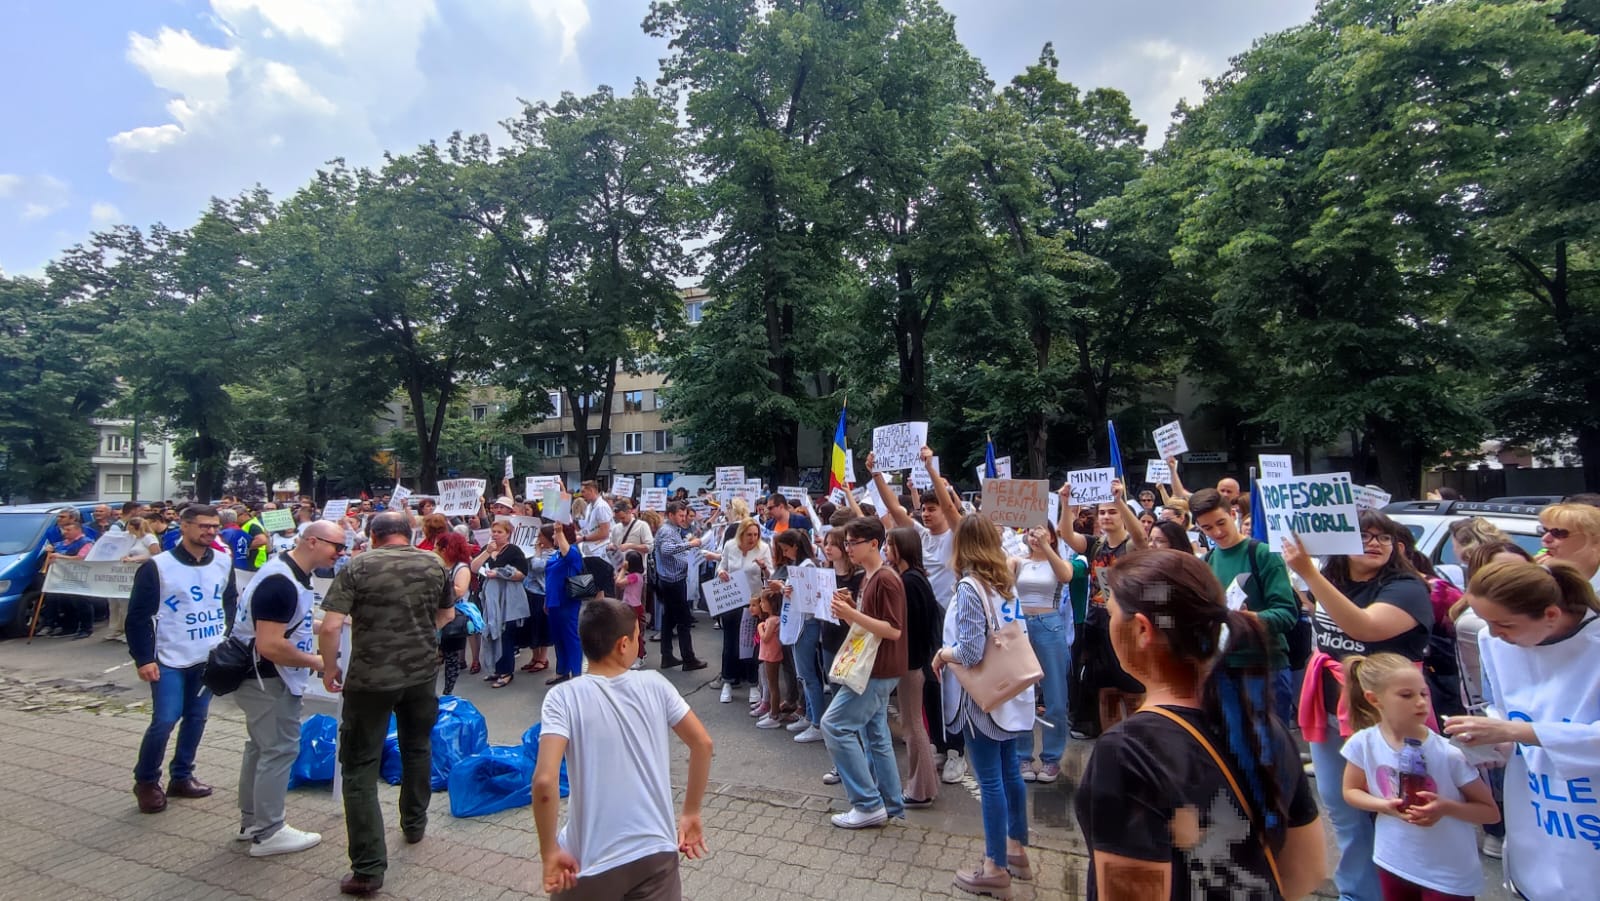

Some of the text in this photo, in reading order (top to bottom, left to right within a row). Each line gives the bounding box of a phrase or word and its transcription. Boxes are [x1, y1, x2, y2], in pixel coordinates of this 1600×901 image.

[1070, 470, 1109, 484] MINIM
[997, 495, 1047, 512] PENTRU
[1456, 503, 1536, 513] DUSTER
[185, 608, 224, 625] SOLE
